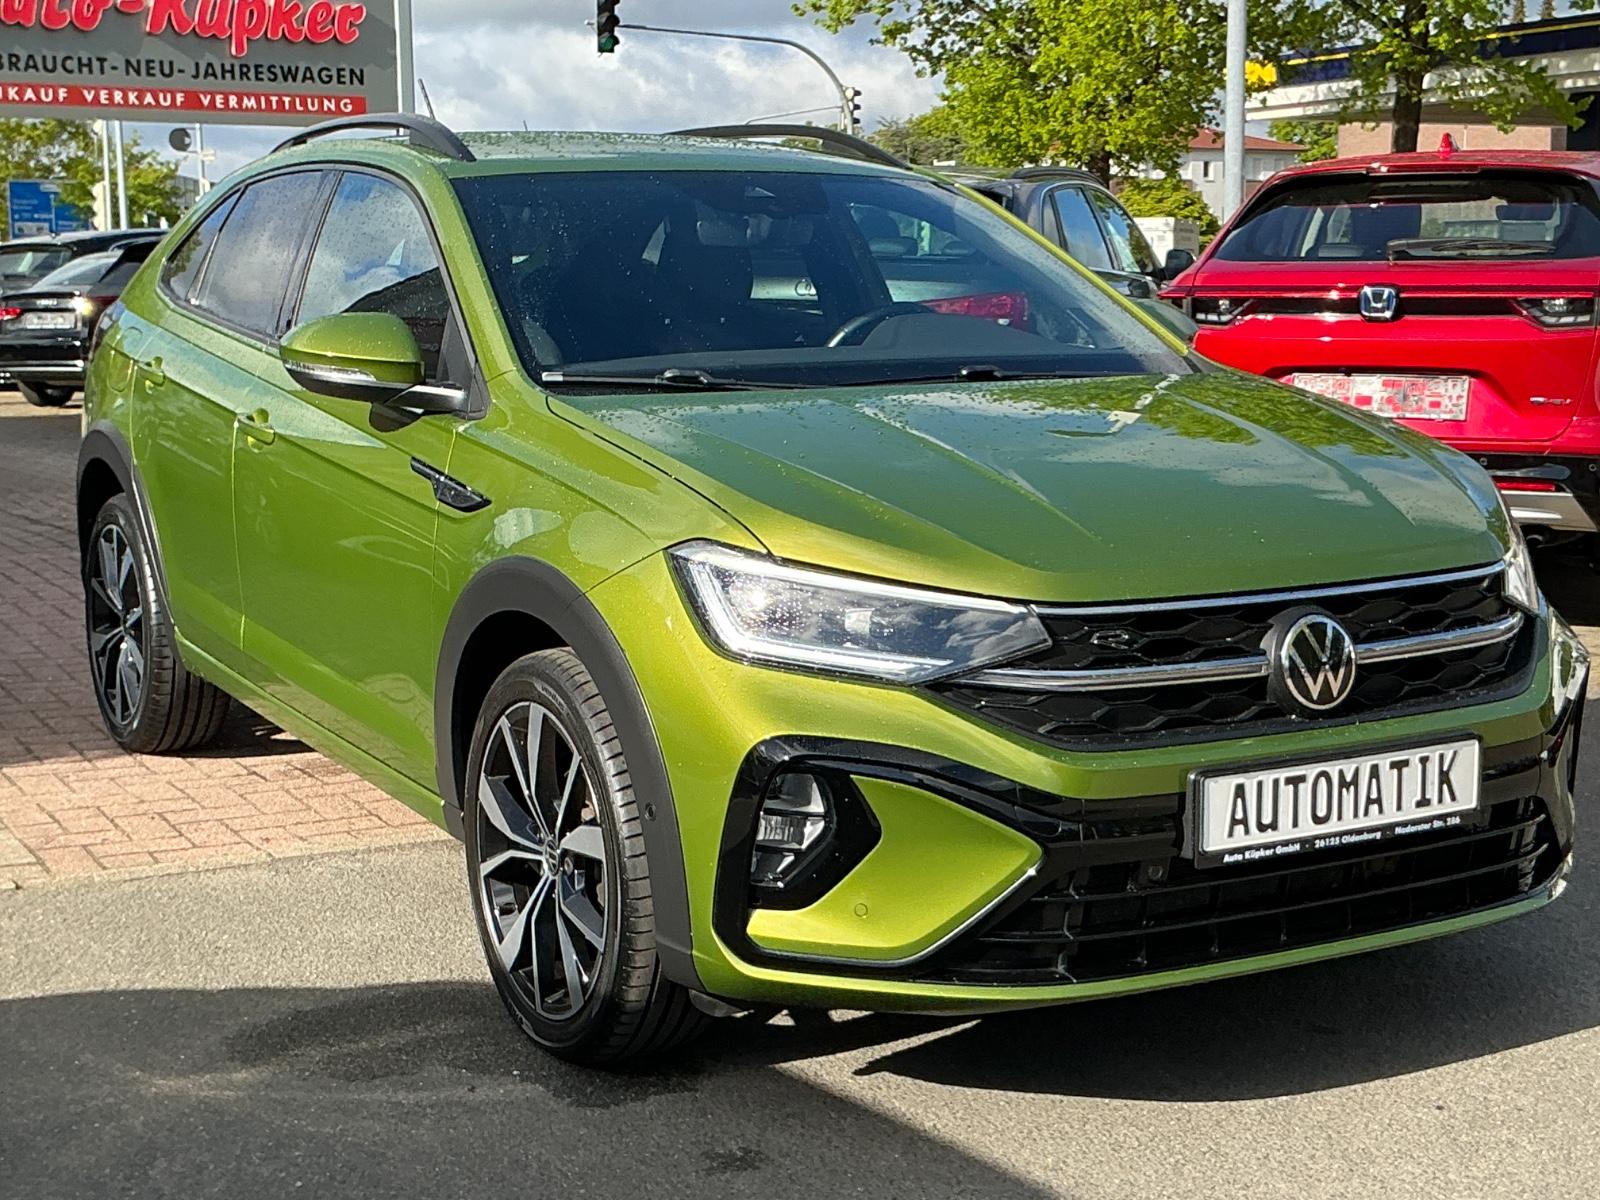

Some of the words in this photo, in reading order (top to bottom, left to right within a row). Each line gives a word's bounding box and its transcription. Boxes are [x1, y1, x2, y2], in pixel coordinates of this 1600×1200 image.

[83, 88, 186, 107] VERKAUF
[199, 93, 353, 113] VERMITTLUNG
[1227, 750, 1458, 839] AUTOMATIK
[1222, 853, 1243, 864] Auto
[1275, 842, 1300, 854] GmbH
[1341, 830, 1382, 844] Oldenburg
